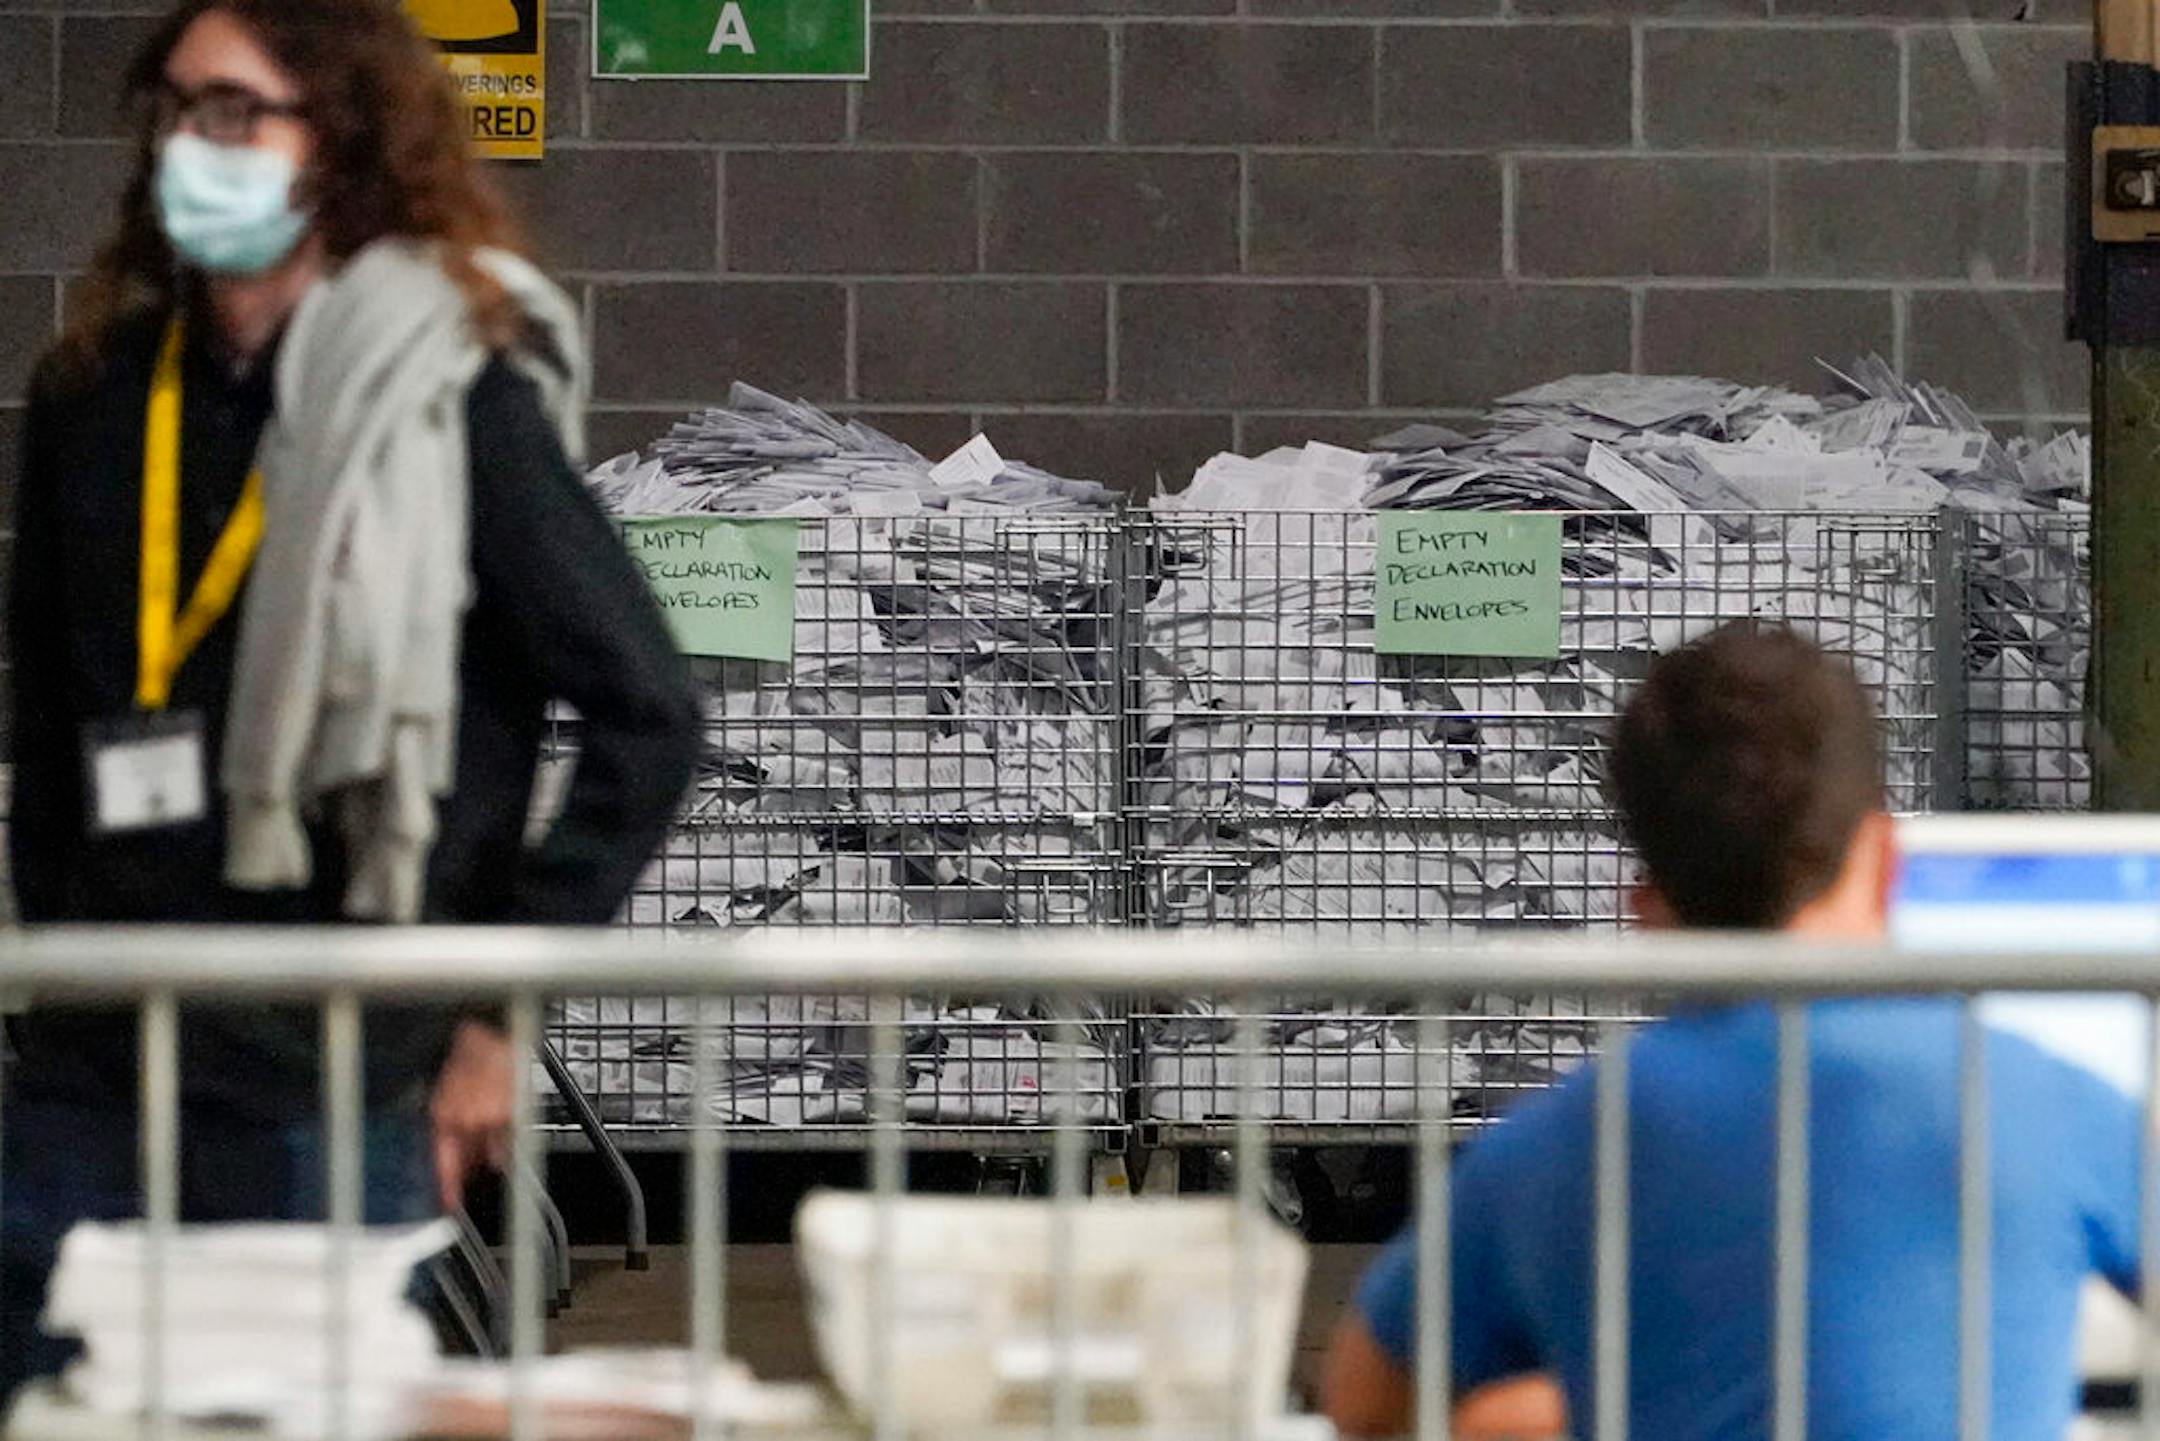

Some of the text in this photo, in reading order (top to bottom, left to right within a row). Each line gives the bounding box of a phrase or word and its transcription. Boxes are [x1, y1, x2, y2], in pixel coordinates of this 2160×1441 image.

[707, 1, 756, 54] A
[450, 74, 537, 94] VERINGS
[465, 106, 536, 136] RED
[1396, 528, 1489, 554] EMPTY
[1385, 559, 1537, 586] DECLARATION
[654, 591, 760, 610] NVELOPES
[1393, 597, 1529, 622] ENVELOPES
